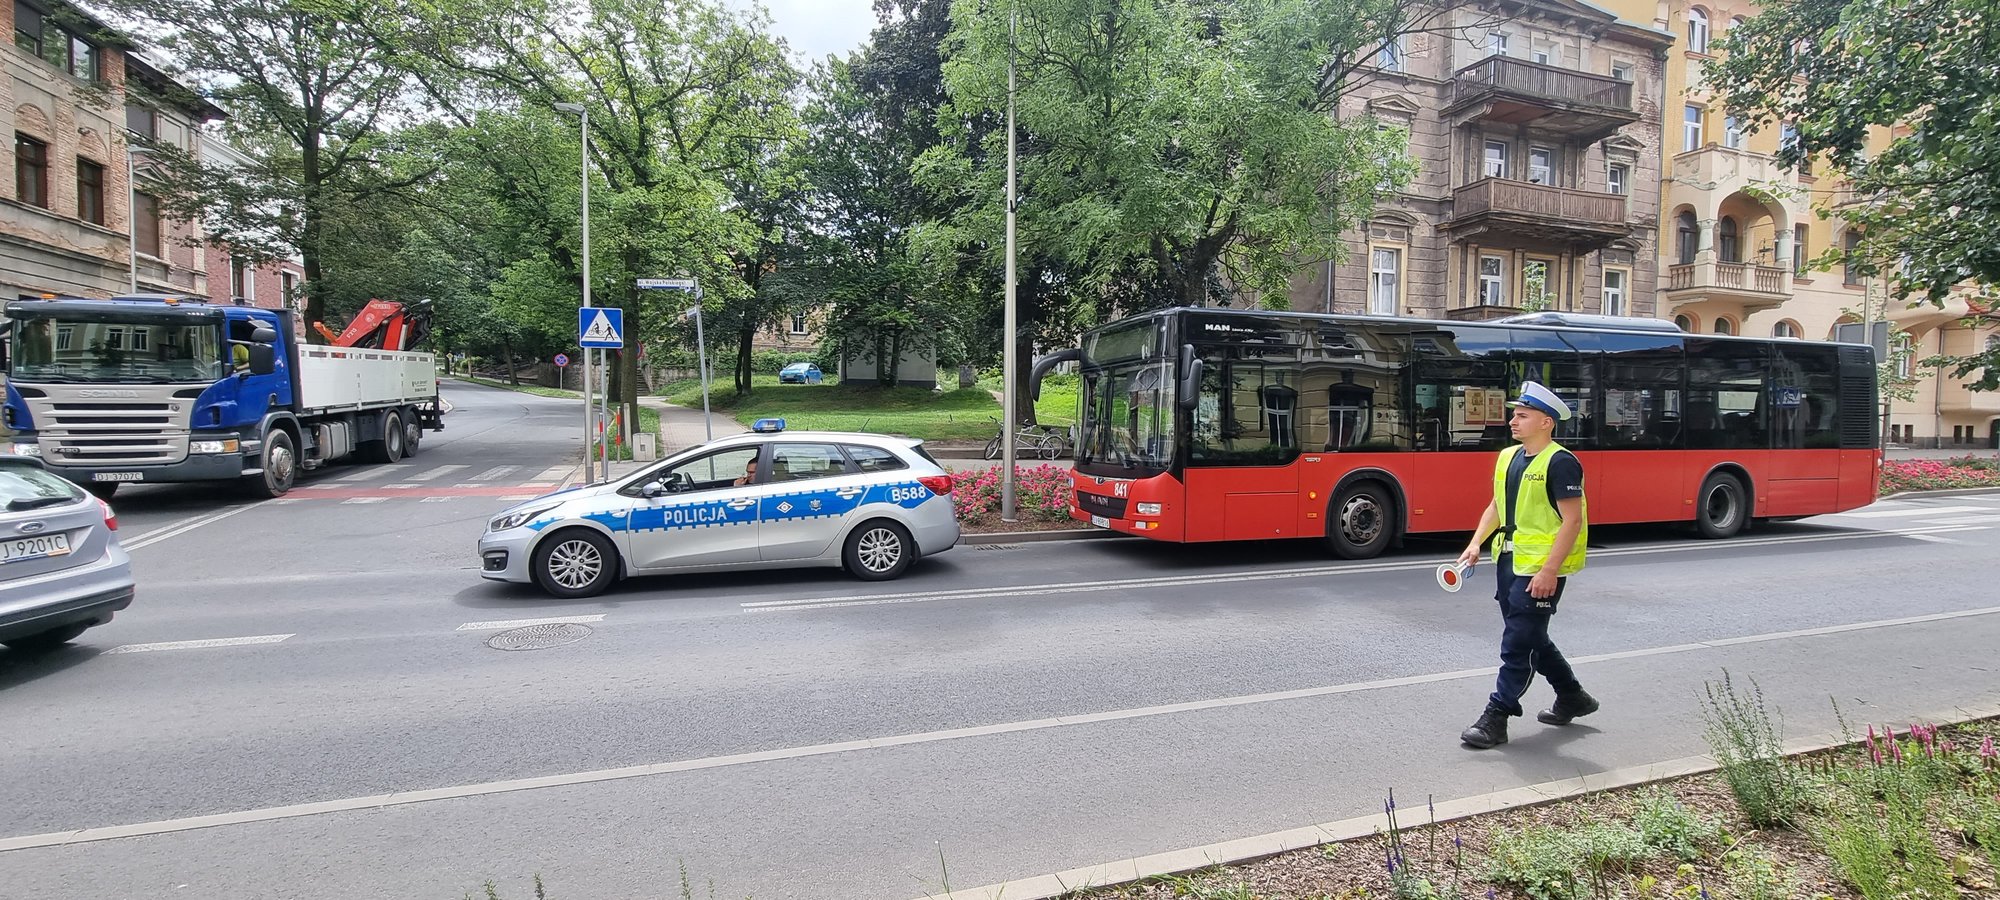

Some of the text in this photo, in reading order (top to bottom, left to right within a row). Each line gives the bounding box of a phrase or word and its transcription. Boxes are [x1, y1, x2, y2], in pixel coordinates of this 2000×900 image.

[79, 389, 139, 398] SCANIA
[891, 486, 926, 502] B588
[1114, 482, 1128, 497] 841
[664, 506, 728, 525] POLICJA
[17, 536, 65, 556] 9201C
